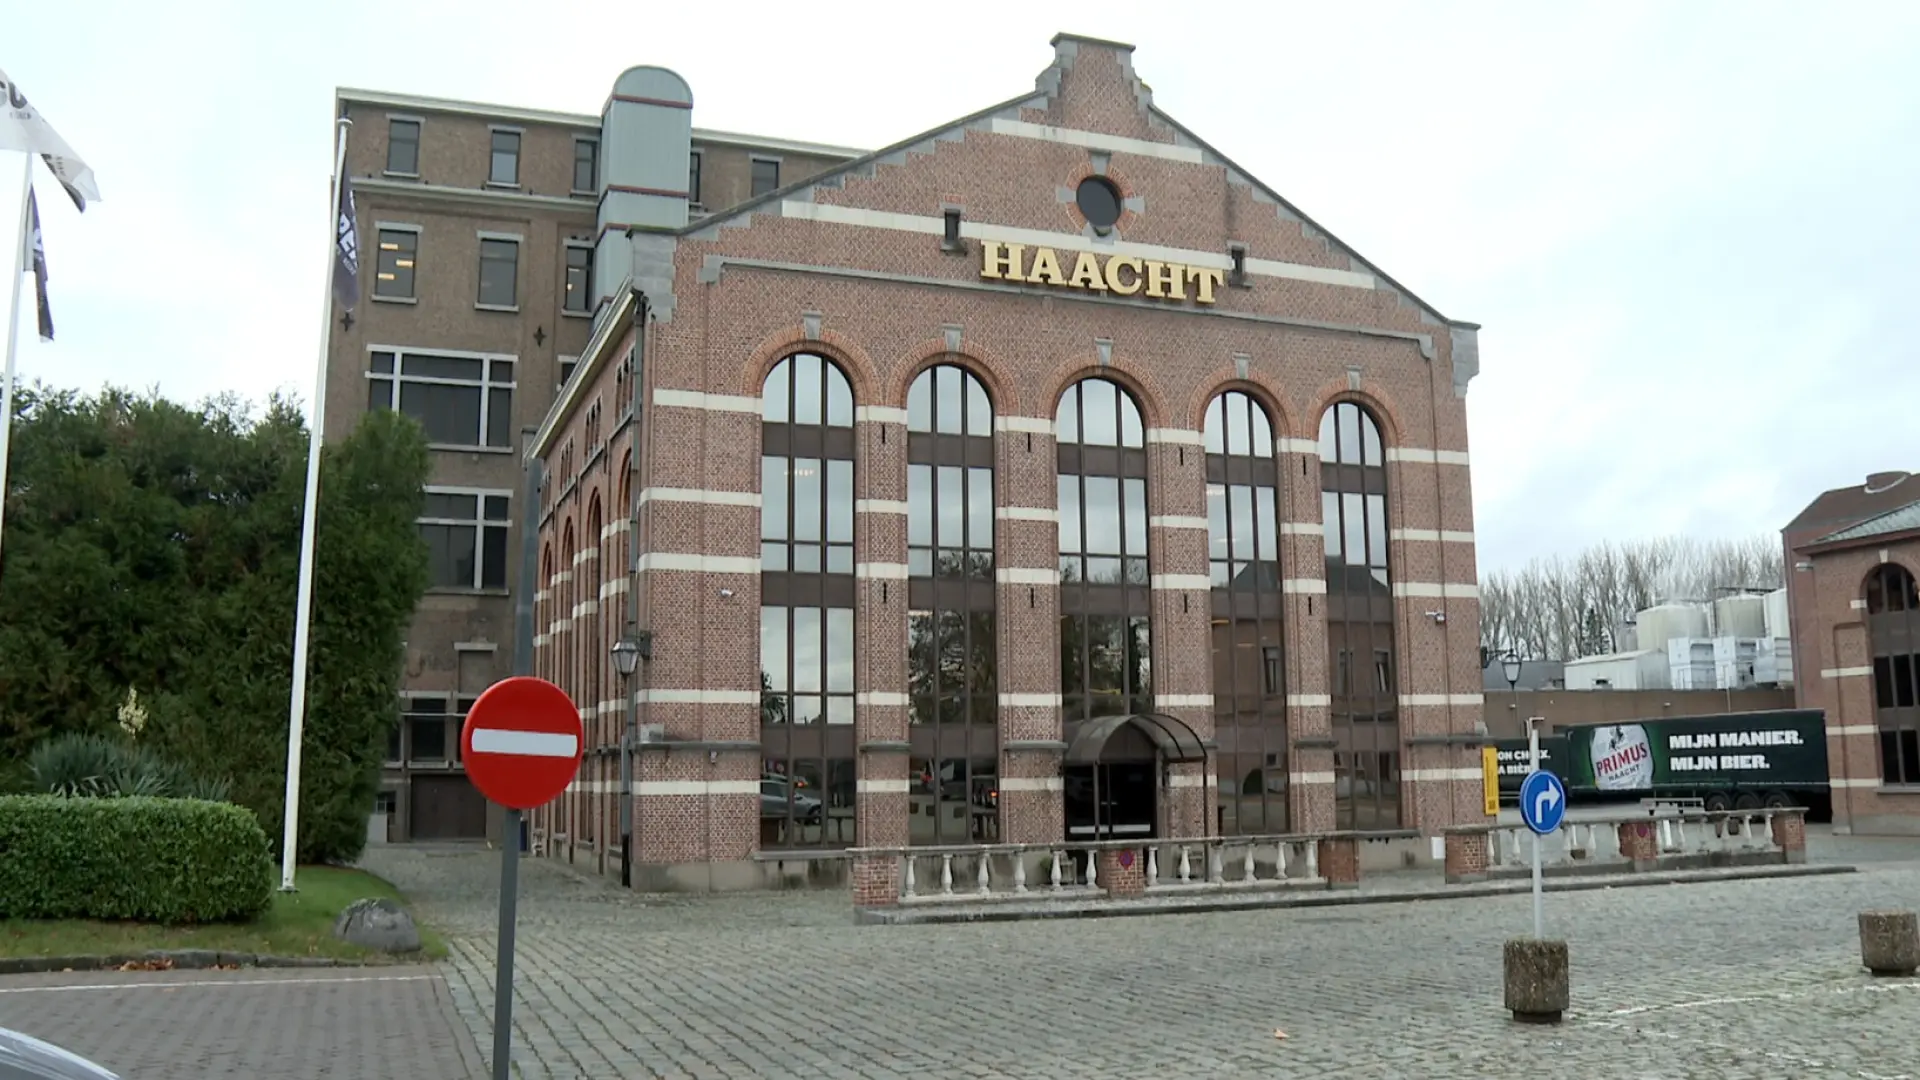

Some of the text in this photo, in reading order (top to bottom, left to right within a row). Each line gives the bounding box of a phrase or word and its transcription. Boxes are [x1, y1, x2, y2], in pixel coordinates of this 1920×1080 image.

[980, 240, 1224, 303] HAACHT
[1669, 730, 1804, 750] MIJN MANIER.
[1596, 742, 1648, 777] PRIMUS
[1670, 754, 1771, 771] MIJN BIER.
